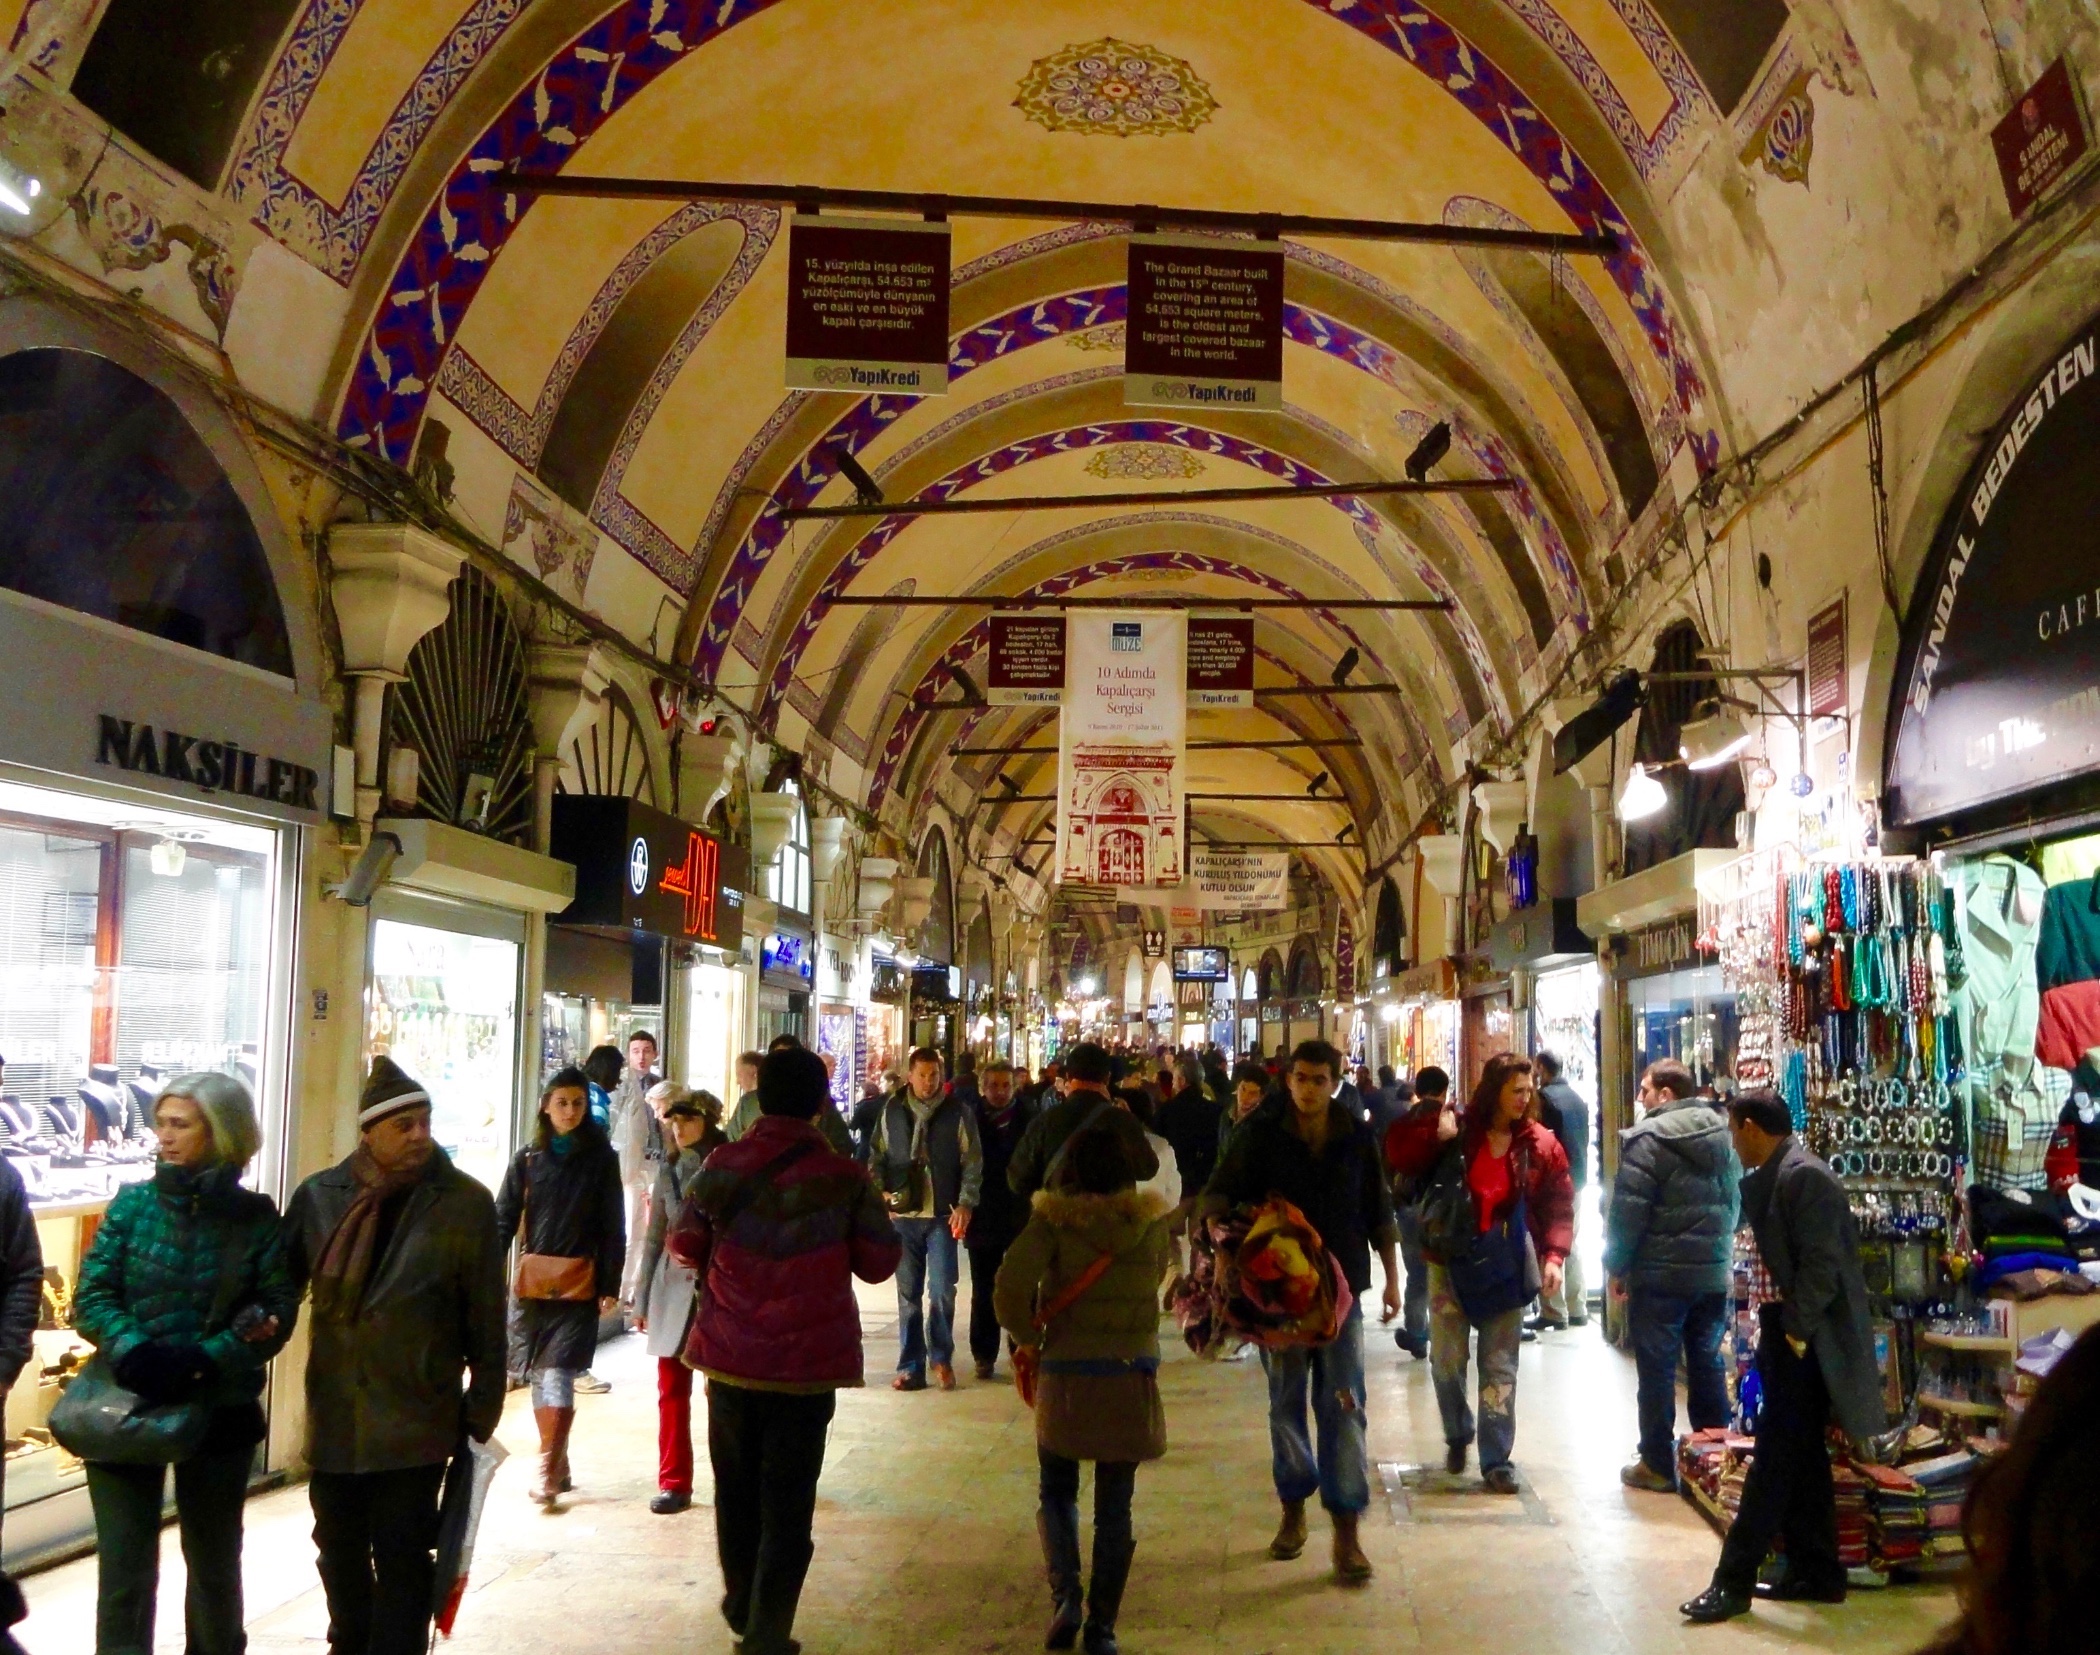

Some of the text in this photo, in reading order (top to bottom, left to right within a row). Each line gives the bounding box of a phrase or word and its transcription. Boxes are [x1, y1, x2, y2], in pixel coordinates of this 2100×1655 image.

[805, 258, 935, 274] 15. yüzyılda inşa edilen
[1144, 261, 1269, 280] The Grand Bazaar built
[808, 272, 874, 286] Kapalıçarşı,
[1155, 276, 1166, 286] in
[1169, 277, 1186, 288] the
[1211, 281, 1256, 295] century,
[802, 287, 936, 302] yüzölçümüyle dünyanın
[1153, 291, 1258, 307] covering an area of
[813, 302, 925, 316] en eski ve en büyük
[1183, 307, 1221, 318] square
[1224, 309, 1264, 321] meters,
[822, 315, 915, 331] kapalı çarşısıdır.
[1159, 318, 1250, 333] is the oldest and
[1142, 331, 1267, 348] largest covered bazaar
[1170, 346, 1238, 361] in the world.
[850, 366, 921, 387] YapıKredi
[1187, 383, 1256, 403] YapıKredi
[1913, 335, 2096, 718] SANDAL BEDESTEN
[1097, 666, 1156, 680] 10 Adımda
[1096, 684, 1156, 700] Kapalıçarşı
[1106, 702, 1144, 717] Sergisi
[96, 713, 319, 811] NAKŞİLER
[1193, 869, 1231, 881] KURULUŞ
[1200, 883, 1256, 892] KUTLU OLSUN
